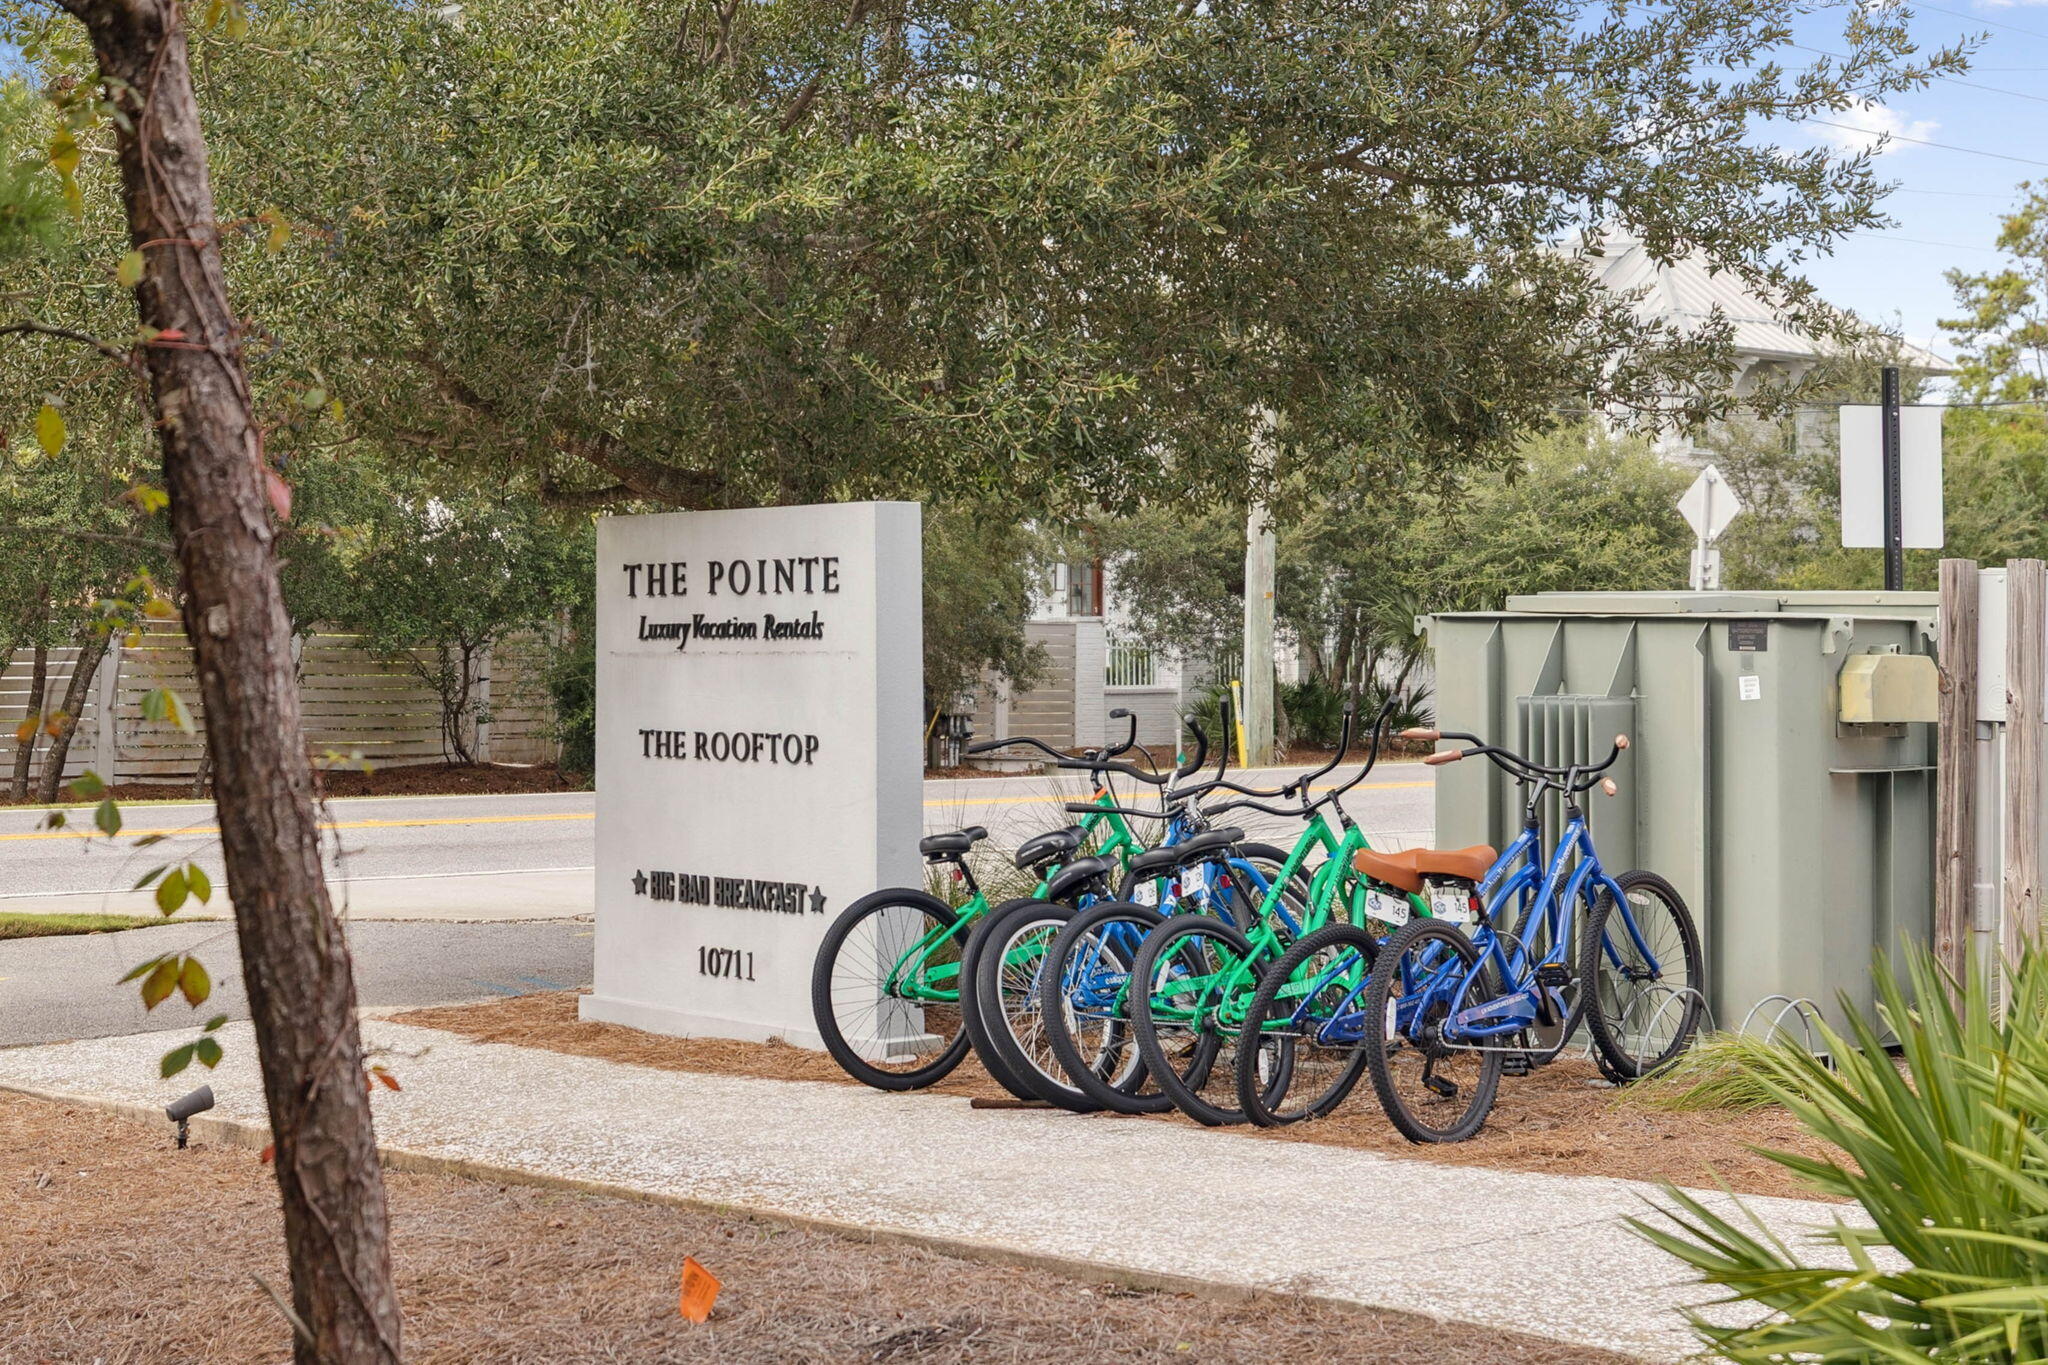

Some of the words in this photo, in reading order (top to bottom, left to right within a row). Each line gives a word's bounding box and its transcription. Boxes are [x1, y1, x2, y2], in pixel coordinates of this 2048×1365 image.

[623, 562, 687, 598] THE
[707, 556, 840, 596] POINTE
[638, 615, 691, 650] Luxury
[692, 613, 757, 641] Vacation
[763, 610, 825, 640] Rentals
[638, 729, 687, 760] THE
[694, 731, 819, 765] ROOFTOP
[650, 870, 675, 901] BIG
[678, 873, 710, 906] BAD
[714, 876, 808, 915] BREAKFAST
[1392, 905, 1407, 919] 145
[698, 946, 755, 982] 10711
